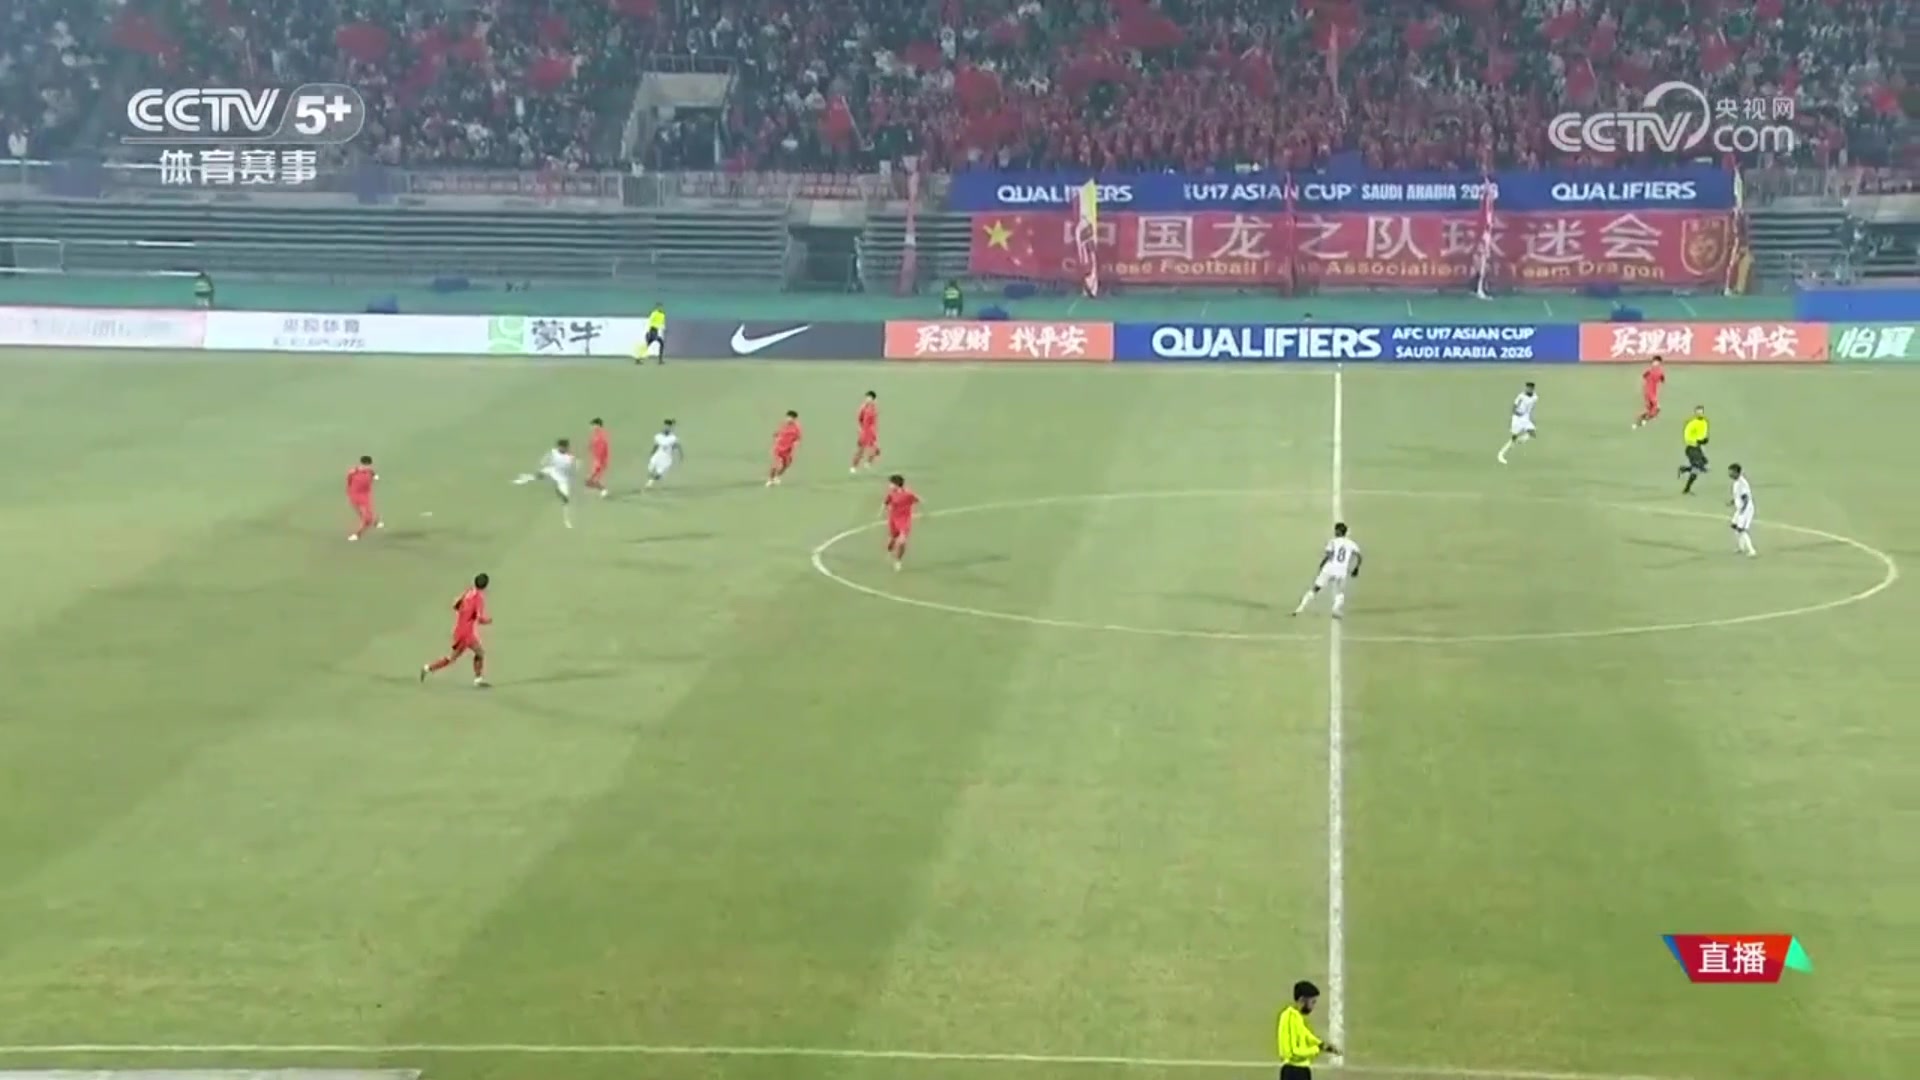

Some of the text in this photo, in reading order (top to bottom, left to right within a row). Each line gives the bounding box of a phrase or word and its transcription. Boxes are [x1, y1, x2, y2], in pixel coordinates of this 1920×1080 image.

[1230, 183, 1299, 200] ASIAN
[1304, 183, 1351, 200] CUP
[1361, 183, 1403, 200] SAUDI
[1406, 183, 1457, 201] ARABIA
[1551, 181, 1697, 201] QUALIFIERS
[914, 324, 1088, 358] 买理财 找平安
[1151, 326, 1382, 359] QUALIFIERS
[1391, 326, 1424, 341] AFC
[1452, 326, 1499, 341] ASIAN
[1501, 326, 1535, 341] CUP
[1610, 325, 1799, 358] 买理财 找平安
[1395, 345, 1534, 359] SAUDI ARABIA 2026
